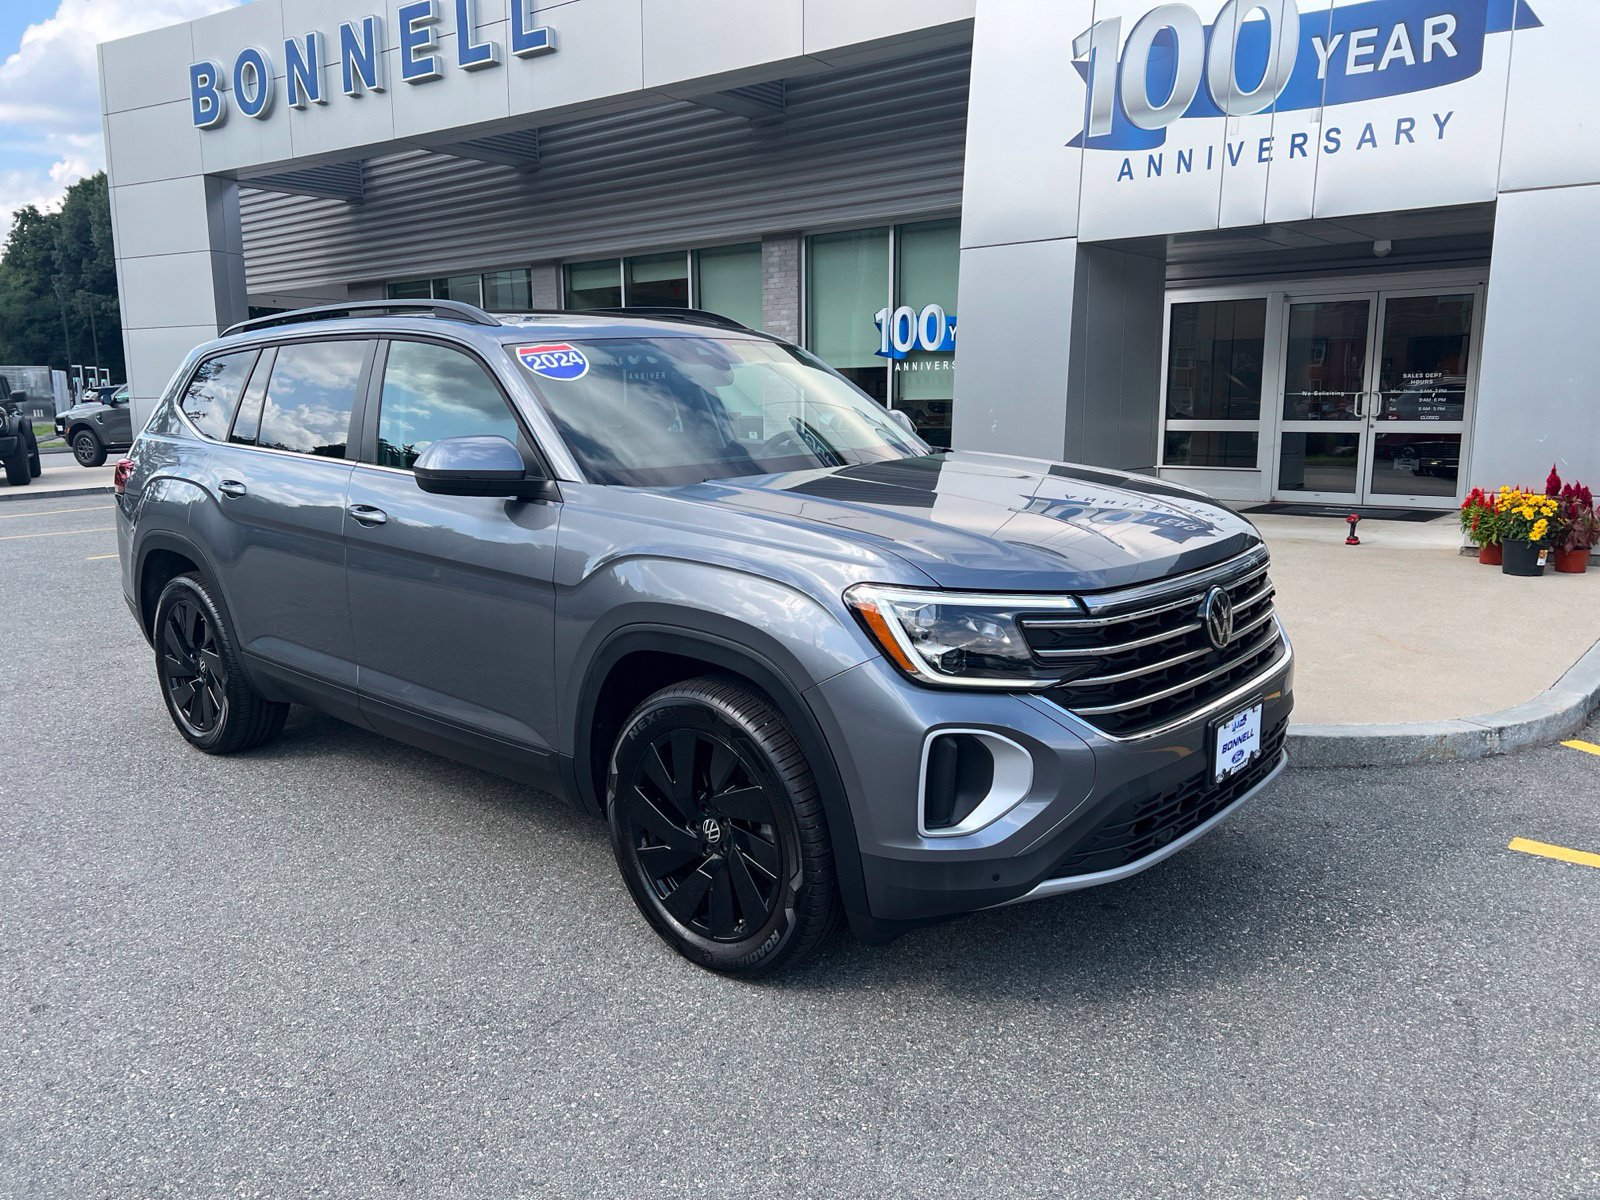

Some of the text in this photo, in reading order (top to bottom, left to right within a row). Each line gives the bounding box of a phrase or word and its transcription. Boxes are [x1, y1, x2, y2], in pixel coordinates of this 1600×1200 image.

[189, 0, 556, 129] BONNELL
[1072, 0, 1458, 137] 100 YEAR
[1117, 111, 1455, 181] ANNIVERSARY
[874, 304, 946, 353] 100
[526, 351, 584, 370] 2024
[1221, 728, 1255, 755] BONNELL
